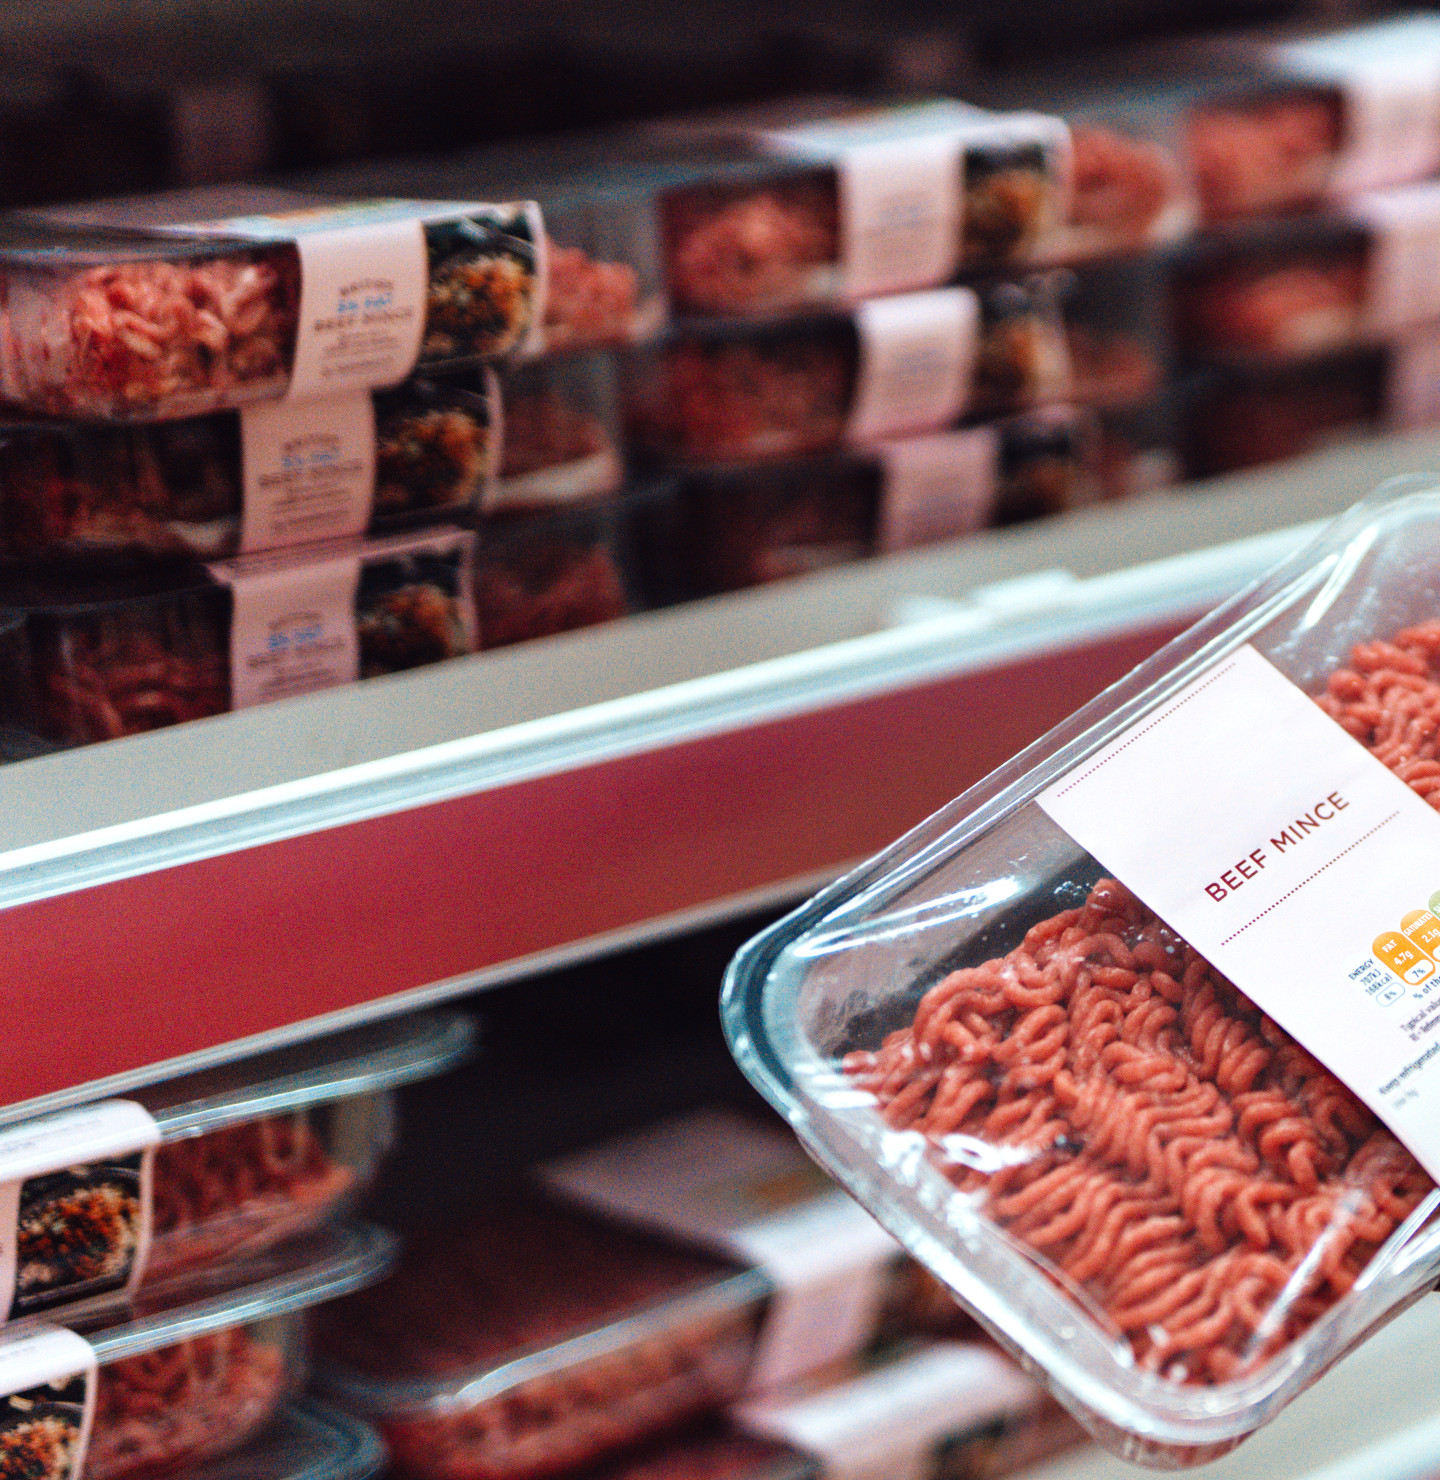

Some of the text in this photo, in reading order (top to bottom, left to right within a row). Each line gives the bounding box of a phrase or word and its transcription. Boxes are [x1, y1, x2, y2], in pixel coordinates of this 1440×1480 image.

[1204, 791, 1350, 903] BEEF MINCE
[1403, 912, 1433, 936] SATURATES
[1382, 939, 1397, 953] FAT
[1394, 950, 1414, 965] 4.7g
[1412, 969, 1425, 978] 7%
[1422, 983, 1432, 994] of
